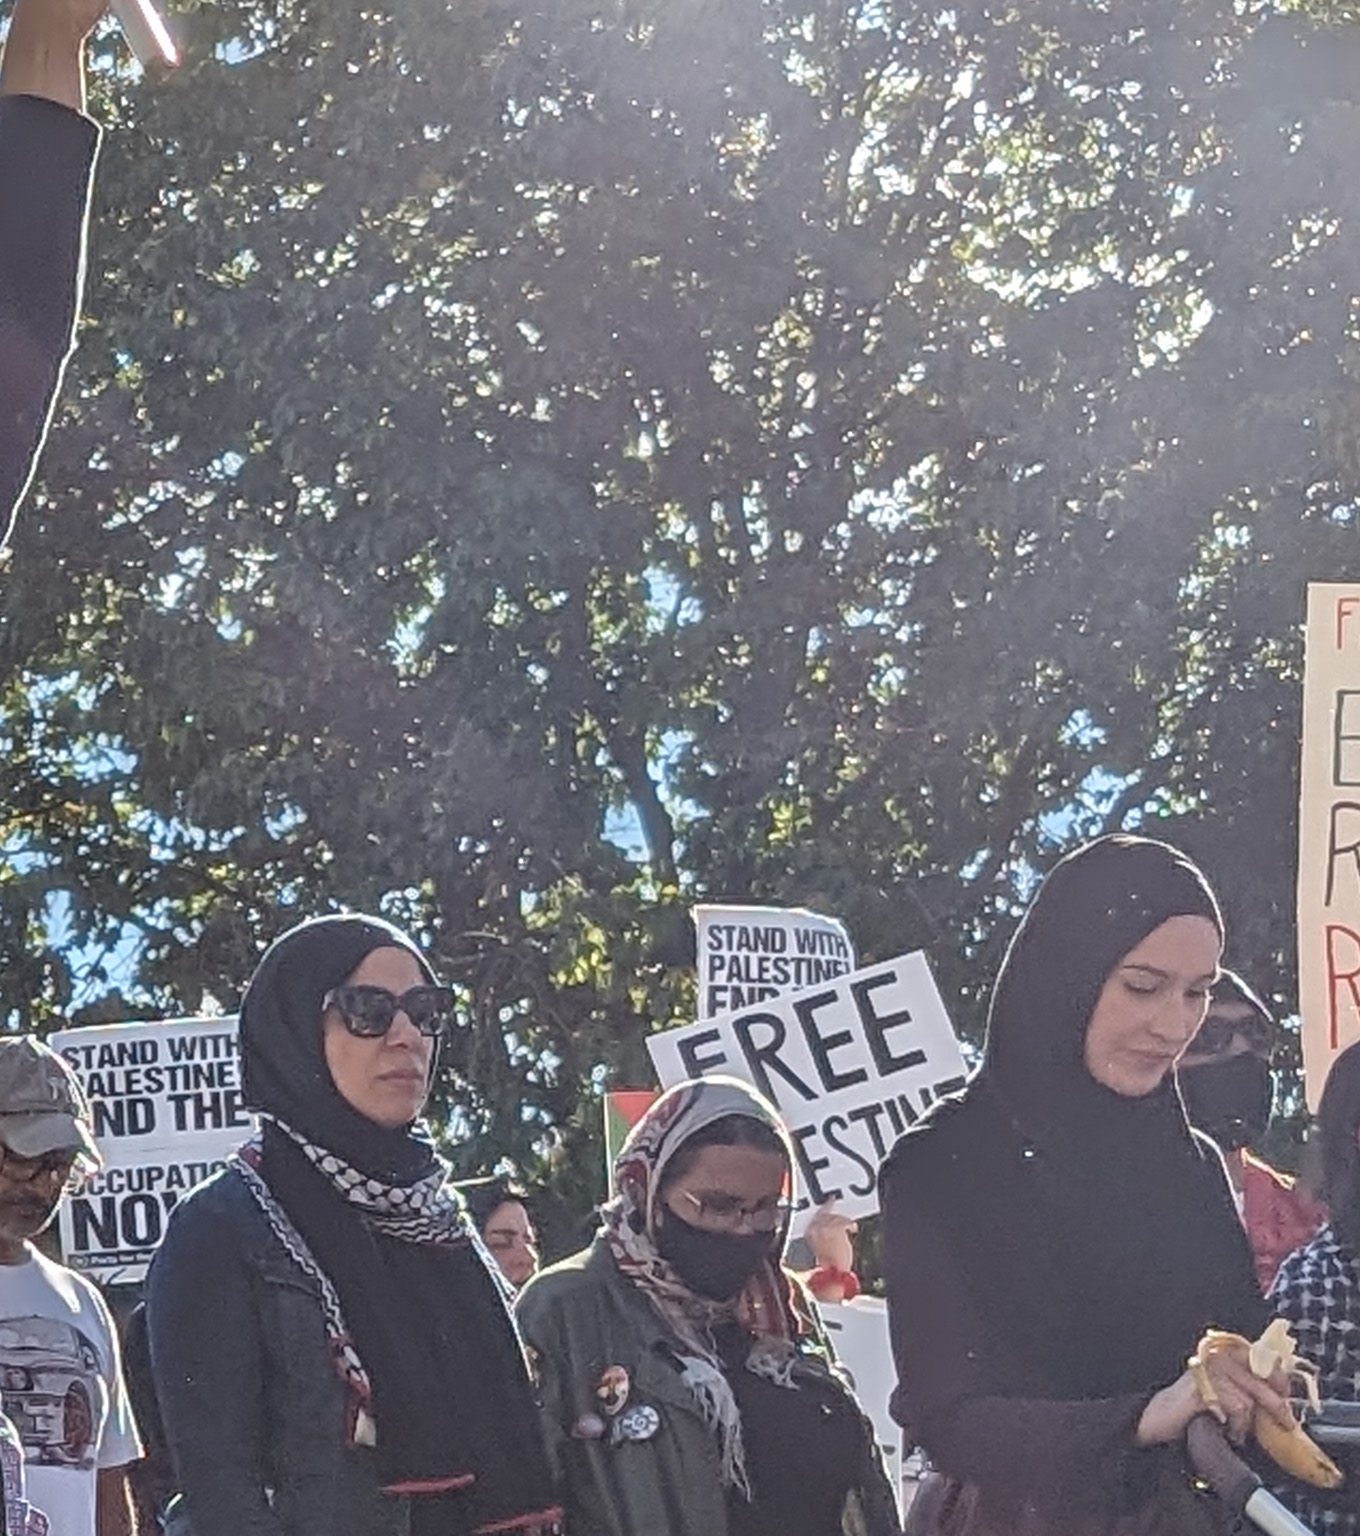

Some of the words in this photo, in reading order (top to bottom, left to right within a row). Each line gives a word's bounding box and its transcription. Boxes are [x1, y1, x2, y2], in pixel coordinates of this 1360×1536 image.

[707, 924, 787, 954] STAND
[793, 928, 849, 958] WITH
[60, 1039, 159, 1071] STAND
[676, 970, 927, 1102] FREE
[78, 1061, 237, 1099] ALESTINE
[92, 1097, 157, 1138] ND
[166, 1090, 252, 1132] THE
[795, 1074, 967, 1212] ESTIN
